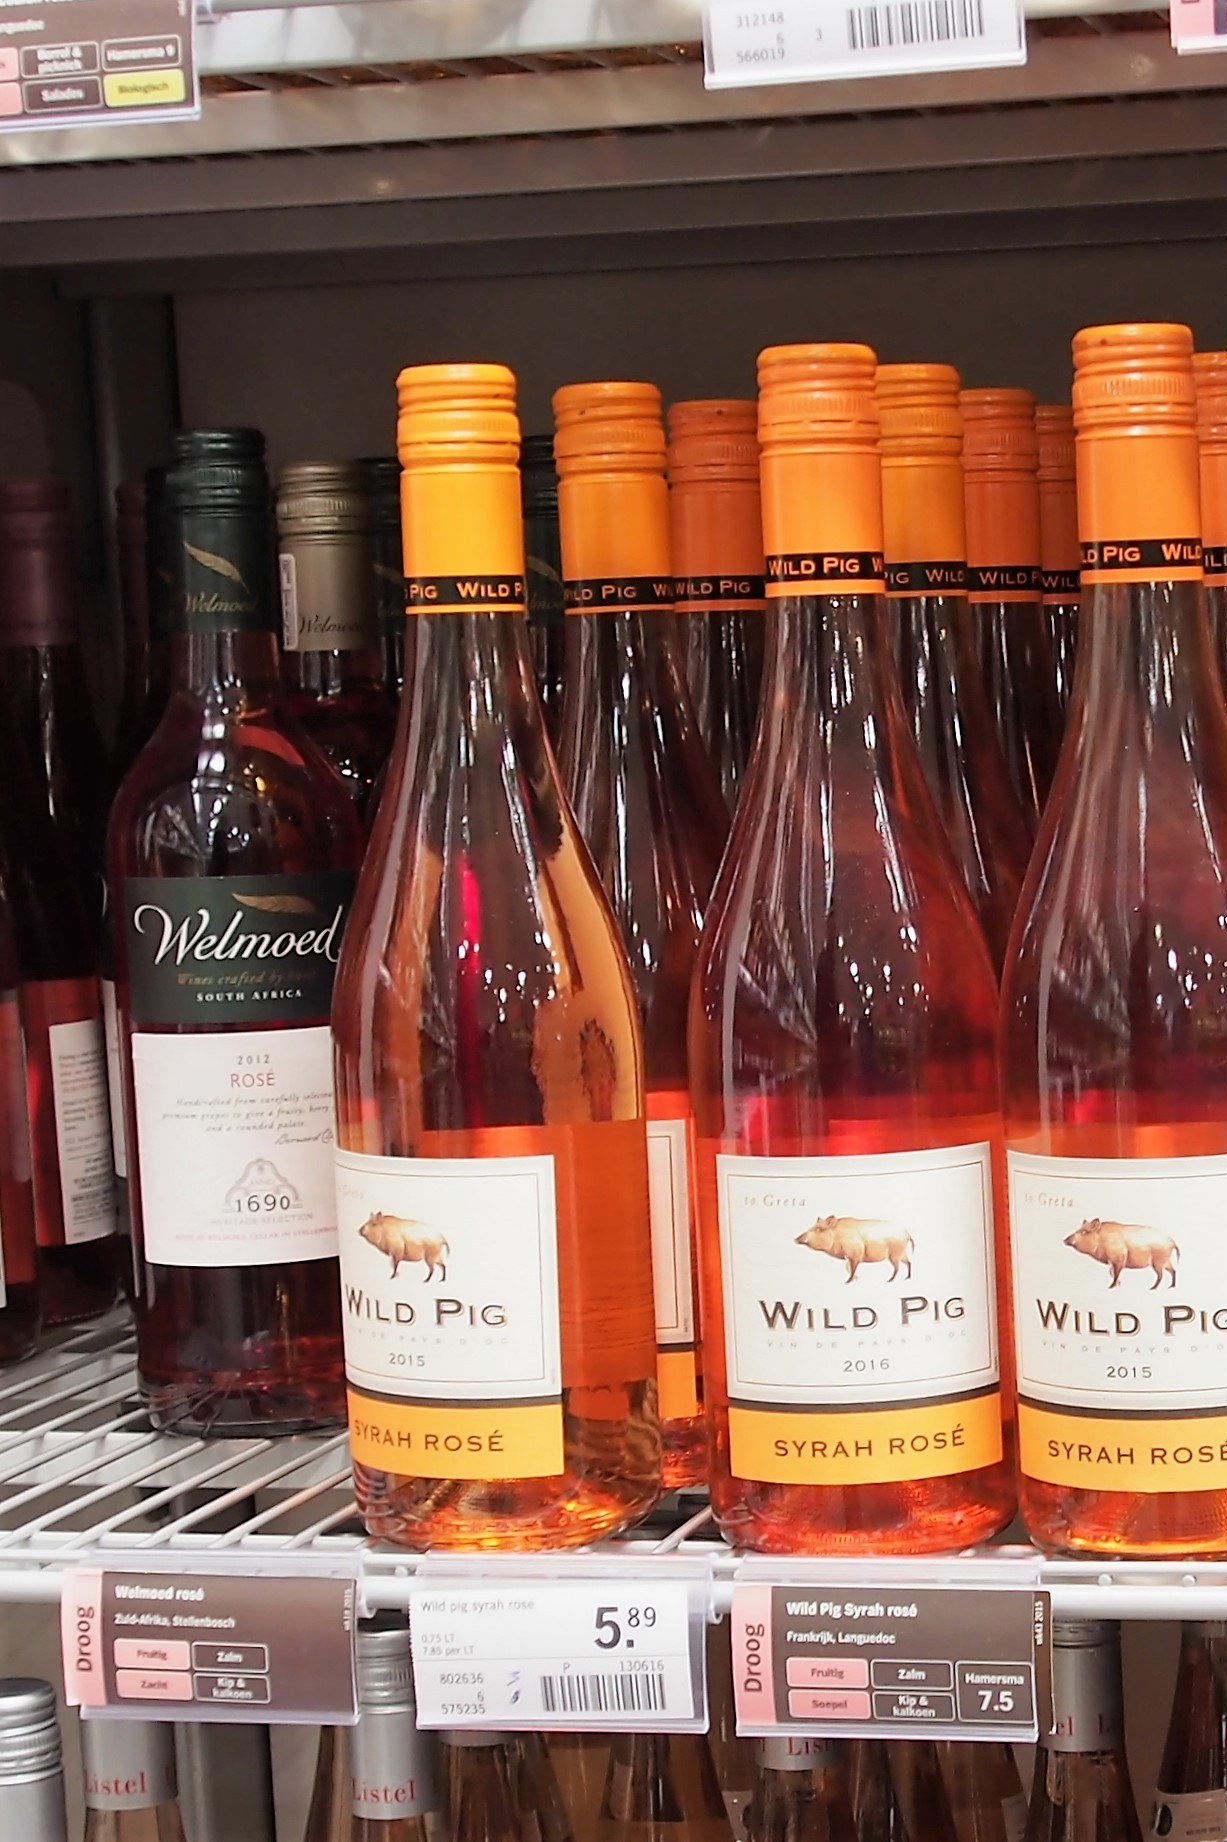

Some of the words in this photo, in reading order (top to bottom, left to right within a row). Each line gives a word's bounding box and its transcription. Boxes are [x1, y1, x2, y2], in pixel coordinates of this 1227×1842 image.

[736, 12, 784, 28] 312148
[776, 32, 784, 45] 6
[815, 28, 823, 41] 3
[736, 48, 785, 63] 566019
[1104, 546, 1141, 562] PIG
[768, 559, 815, 576] WILD
[822, 557, 860, 574] PIG
[925, 569, 965, 583] WILD
[979, 571, 1028, 585] WILD
[409, 584, 437, 599] PIG
[456, 581, 509, 598] WILD
[601, 586, 637, 599] PIG
[675, 581, 713, 596] WILD
[719, 580, 751, 593] PIG
[134, 903, 343, 966] Welmoed
[177, 972, 212, 986] Wines
[217, 971, 265, 987] crafted
[196, 992, 245, 1003] SOUTH
[251, 989, 302, 1001] AFRICA
[237, 1054, 271, 1066] 2012
[230, 1068, 276, 1089] ROSÉ
[234, 1193, 291, 1213] 1690
[763, 1194, 806, 1208] Greta
[1038, 1193, 1074, 1208] Greta
[345, 1283, 415, 1325] WILD
[435, 1298, 508, 1327] PIG
[759, 1299, 879, 1332] WILD
[900, 1296, 966, 1327] PIG
[1036, 1298, 1141, 1337] WILD
[766, 1341, 798, 1349] VIN
[816, 1341, 838, 1349] DE
[858, 1338, 907, 1347] PAYS
[1042, 1342, 1067, 1350] VIN
[1082, 1344, 1102, 1353] DE
[1120, 1346, 1170, 1354] PAYS
[389, 1352, 425, 1368] 2015
[843, 1358, 890, 1373] 2016
[1107, 1366, 1152, 1379] 2015
[354, 1420, 411, 1449] SYRAH
[425, 1430, 504, 1453] ROSÉ
[774, 1439, 873, 1459] SYRAH
[889, 1424, 966, 1455] ROSÉ
[1048, 1440, 1135, 1465] SYRAH
[115, 1584, 175, 1601] Welmoed
[176, 1586, 204, 1602] rosé
[421, 1601, 446, 1613] Wild
[450, 1601, 468, 1614] pig
[473, 1599, 504, 1613] syrah
[508, 1599, 534, 1610] rose
[786, 1601, 816, 1617] Wild
[819, 1602, 842, 1619] Pig
[844, 1603, 884, 1619] Syrah
[887, 1603, 917, 1619] rosé
[114, 1612, 170, 1628] Zuid-Afrika,
[172, 1615, 235, 1629] Stellenbosch
[594, 1606, 656, 1650] 5.89
[77, 1606, 94, 1672] Droog
[786, 1630, 836, 1646] Frankrijk,
[838, 1631, 896, 1647] Languedoc
[136, 1649, 167, 1662] Fruitig
[216, 1651, 242, 1664] Zalm
[445, 1647, 461, 1657] per
[463, 1645, 474, 1655] LT
[744, 1622, 765, 1693] Droog
[563, 1662, 570, 1673] P
[619, 1659, 664, 1672] 130616
[439, 1672, 484, 1685] 802636
[810, 1667, 844, 1681] Fruitig
[898, 1668, 926, 1681] Zalm
[965, 1672, 1024, 1686] Hamersma
[140, 1679, 167, 1690] Zacht
[217, 1677, 236, 1690] Kip
[237, 1678, 246, 1688] &
[477, 1691, 484, 1702] 6
[898, 1695, 917, 1708] Kip
[919, 1695, 928, 1705] &
[978, 1690, 1014, 1712] 7.5
[441, 1703, 486, 1715] 575235
[811, 1698, 848, 1711] Soepel
[892, 1705, 936, 1718] kalkoen
[84, 1770, 148, 1796] Listel
[351, 1778, 417, 1804] Listel
